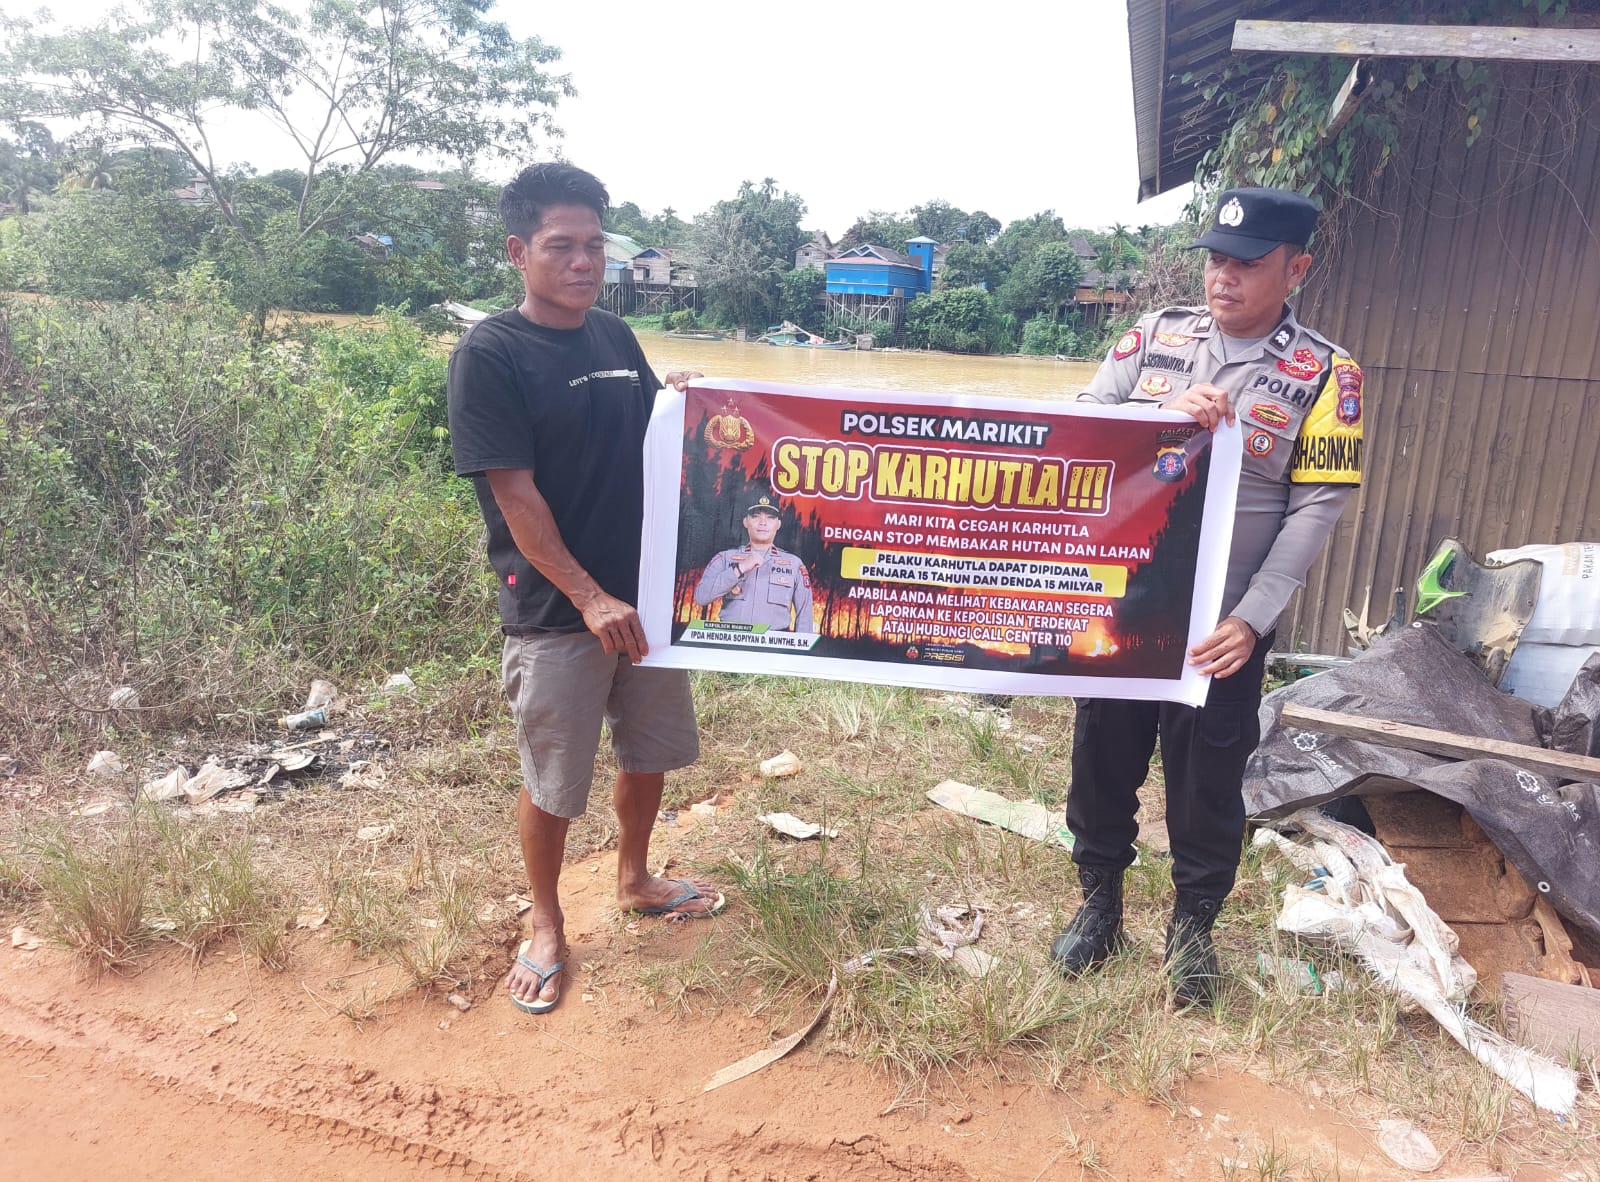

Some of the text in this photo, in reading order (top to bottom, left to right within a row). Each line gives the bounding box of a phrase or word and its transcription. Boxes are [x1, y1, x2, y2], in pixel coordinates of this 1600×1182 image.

[1253, 374, 1312, 408] POLRI
[844, 413, 1048, 445] POLSEK MARIKIT
[778, 443, 1105, 508] STOP KARHUTLA !!!
[885, 513, 1089, 538] MARI KITA CEGAH KARHUTLA
[824, 526, 1150, 559] DENGAN STOP MEMBAKAR HUTAN DAN LAHAN
[771, 566, 793, 575] POLRI
[878, 553, 1088, 577] PELAKU KARHUTLA DAPAT DIPIDANA
[862, 566, 1103, 593] PENJARA 15 TAHUN DAN DENDA 15 MILYAR
[849, 586, 1113, 617] APABILA ANDA MELIHAT KEBAKARAN SEGERA
[871, 604, 1088, 632] LAPORKAN KE KEPOLISIAN TERDEKAT
[691, 631, 704, 639] IPDA
[706, 632, 731, 641] HENDRA
[733, 634, 759, 643] SOPIYAN
[883, 619, 1072, 646] ATAU HUBUNGI CALL CENTER 110
[924, 652, 966, 662] PRESISI
